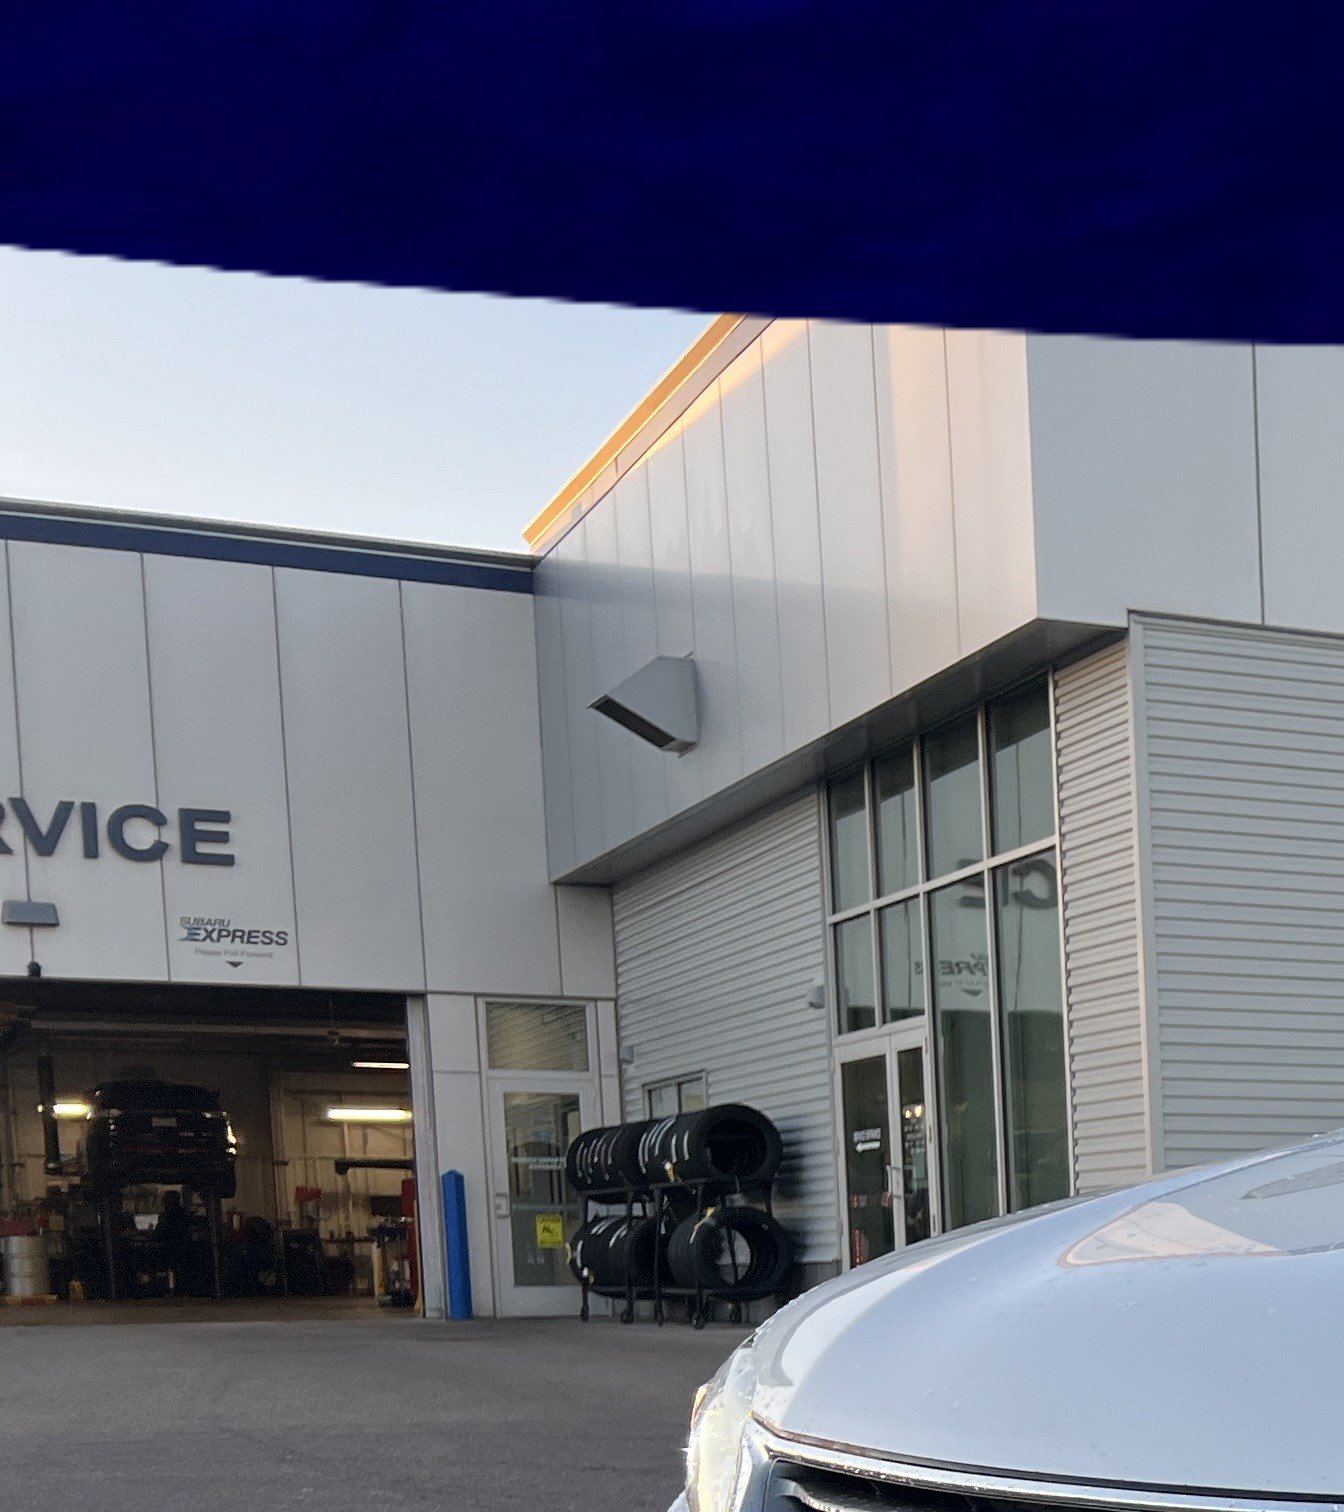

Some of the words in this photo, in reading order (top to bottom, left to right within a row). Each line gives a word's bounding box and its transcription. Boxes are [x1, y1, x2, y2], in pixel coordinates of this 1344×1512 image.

[0, 797, 235, 866] VICE
[180, 916, 231, 928] SUBARU
[178, 926, 289, 946] EXPRESS
